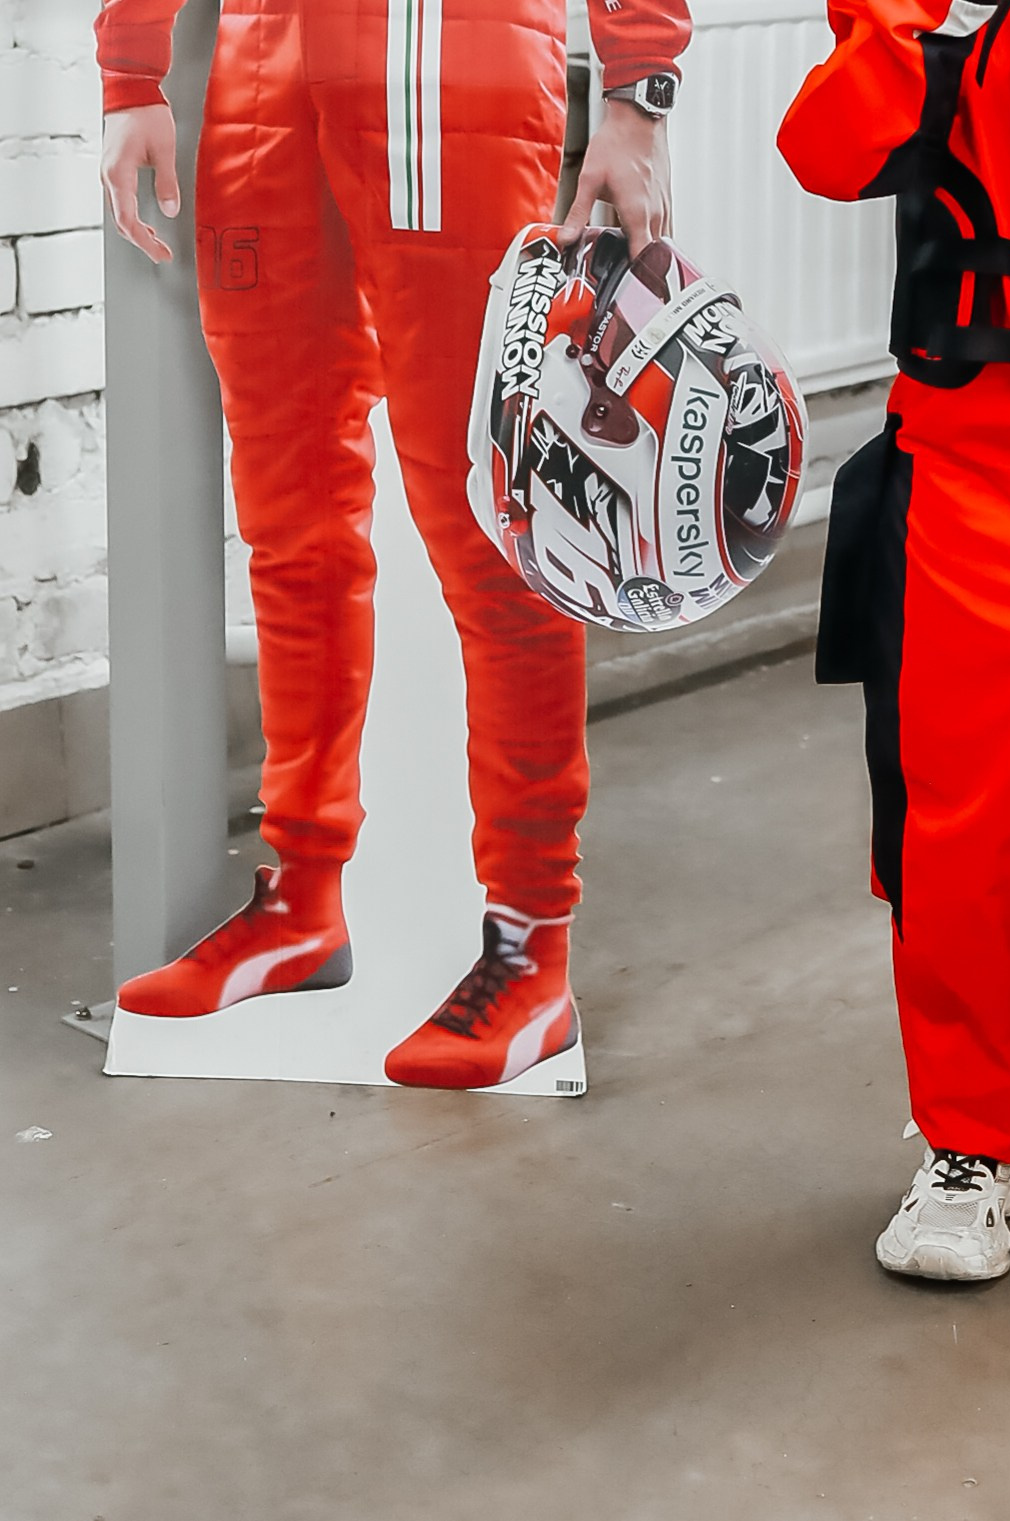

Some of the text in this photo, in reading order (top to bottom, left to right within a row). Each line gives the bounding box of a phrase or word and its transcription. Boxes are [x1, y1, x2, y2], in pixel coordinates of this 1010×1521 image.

[501, 257, 544, 401] WINNOW
[519, 257, 562, 400] MISSION
[590, 311, 613, 352] PASTOR
[671, 387, 720, 576] kaspersky
